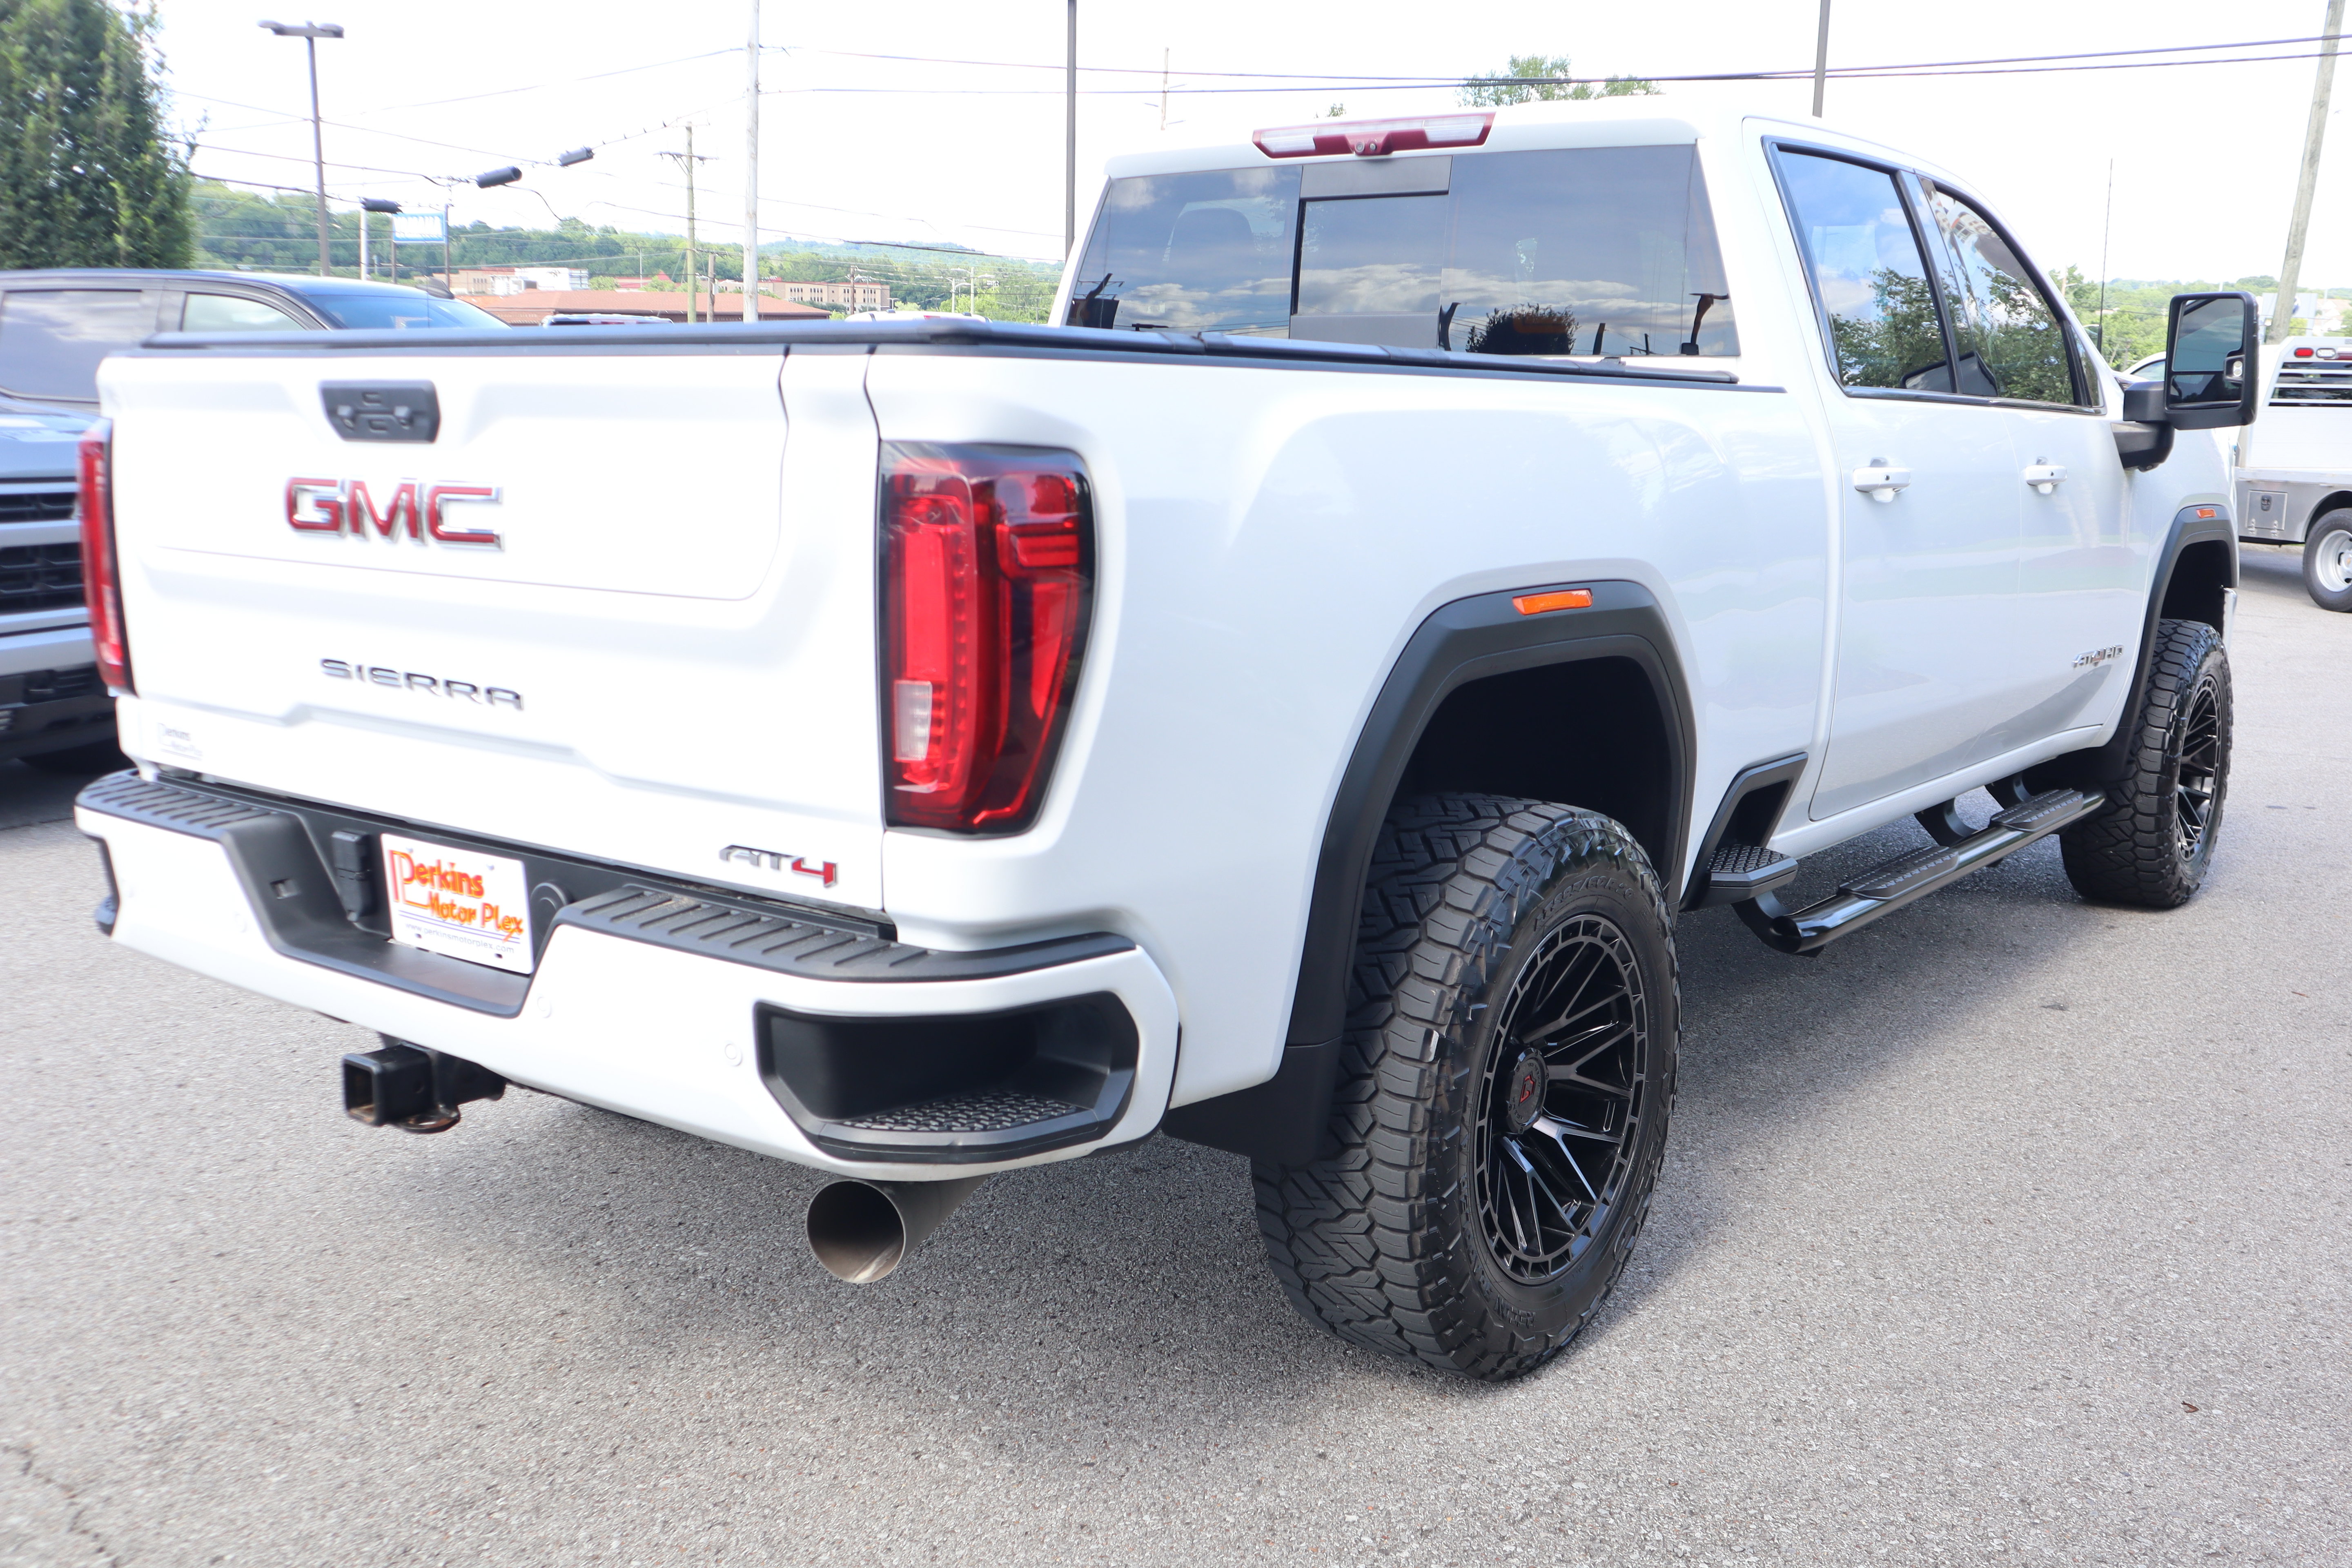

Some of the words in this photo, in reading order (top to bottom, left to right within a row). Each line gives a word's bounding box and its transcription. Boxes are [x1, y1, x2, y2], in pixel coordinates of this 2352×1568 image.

[285, 475, 504, 550] GMC
[320, 658, 524, 711] SIERRA
[388, 849, 485, 903] Perkins
[719, 841, 838, 888] AT4
[405, 922, 515, 954] www.perkinsmotorplex.com
[428, 890, 477, 924] Motor
[480, 902, 524, 941] Plex
